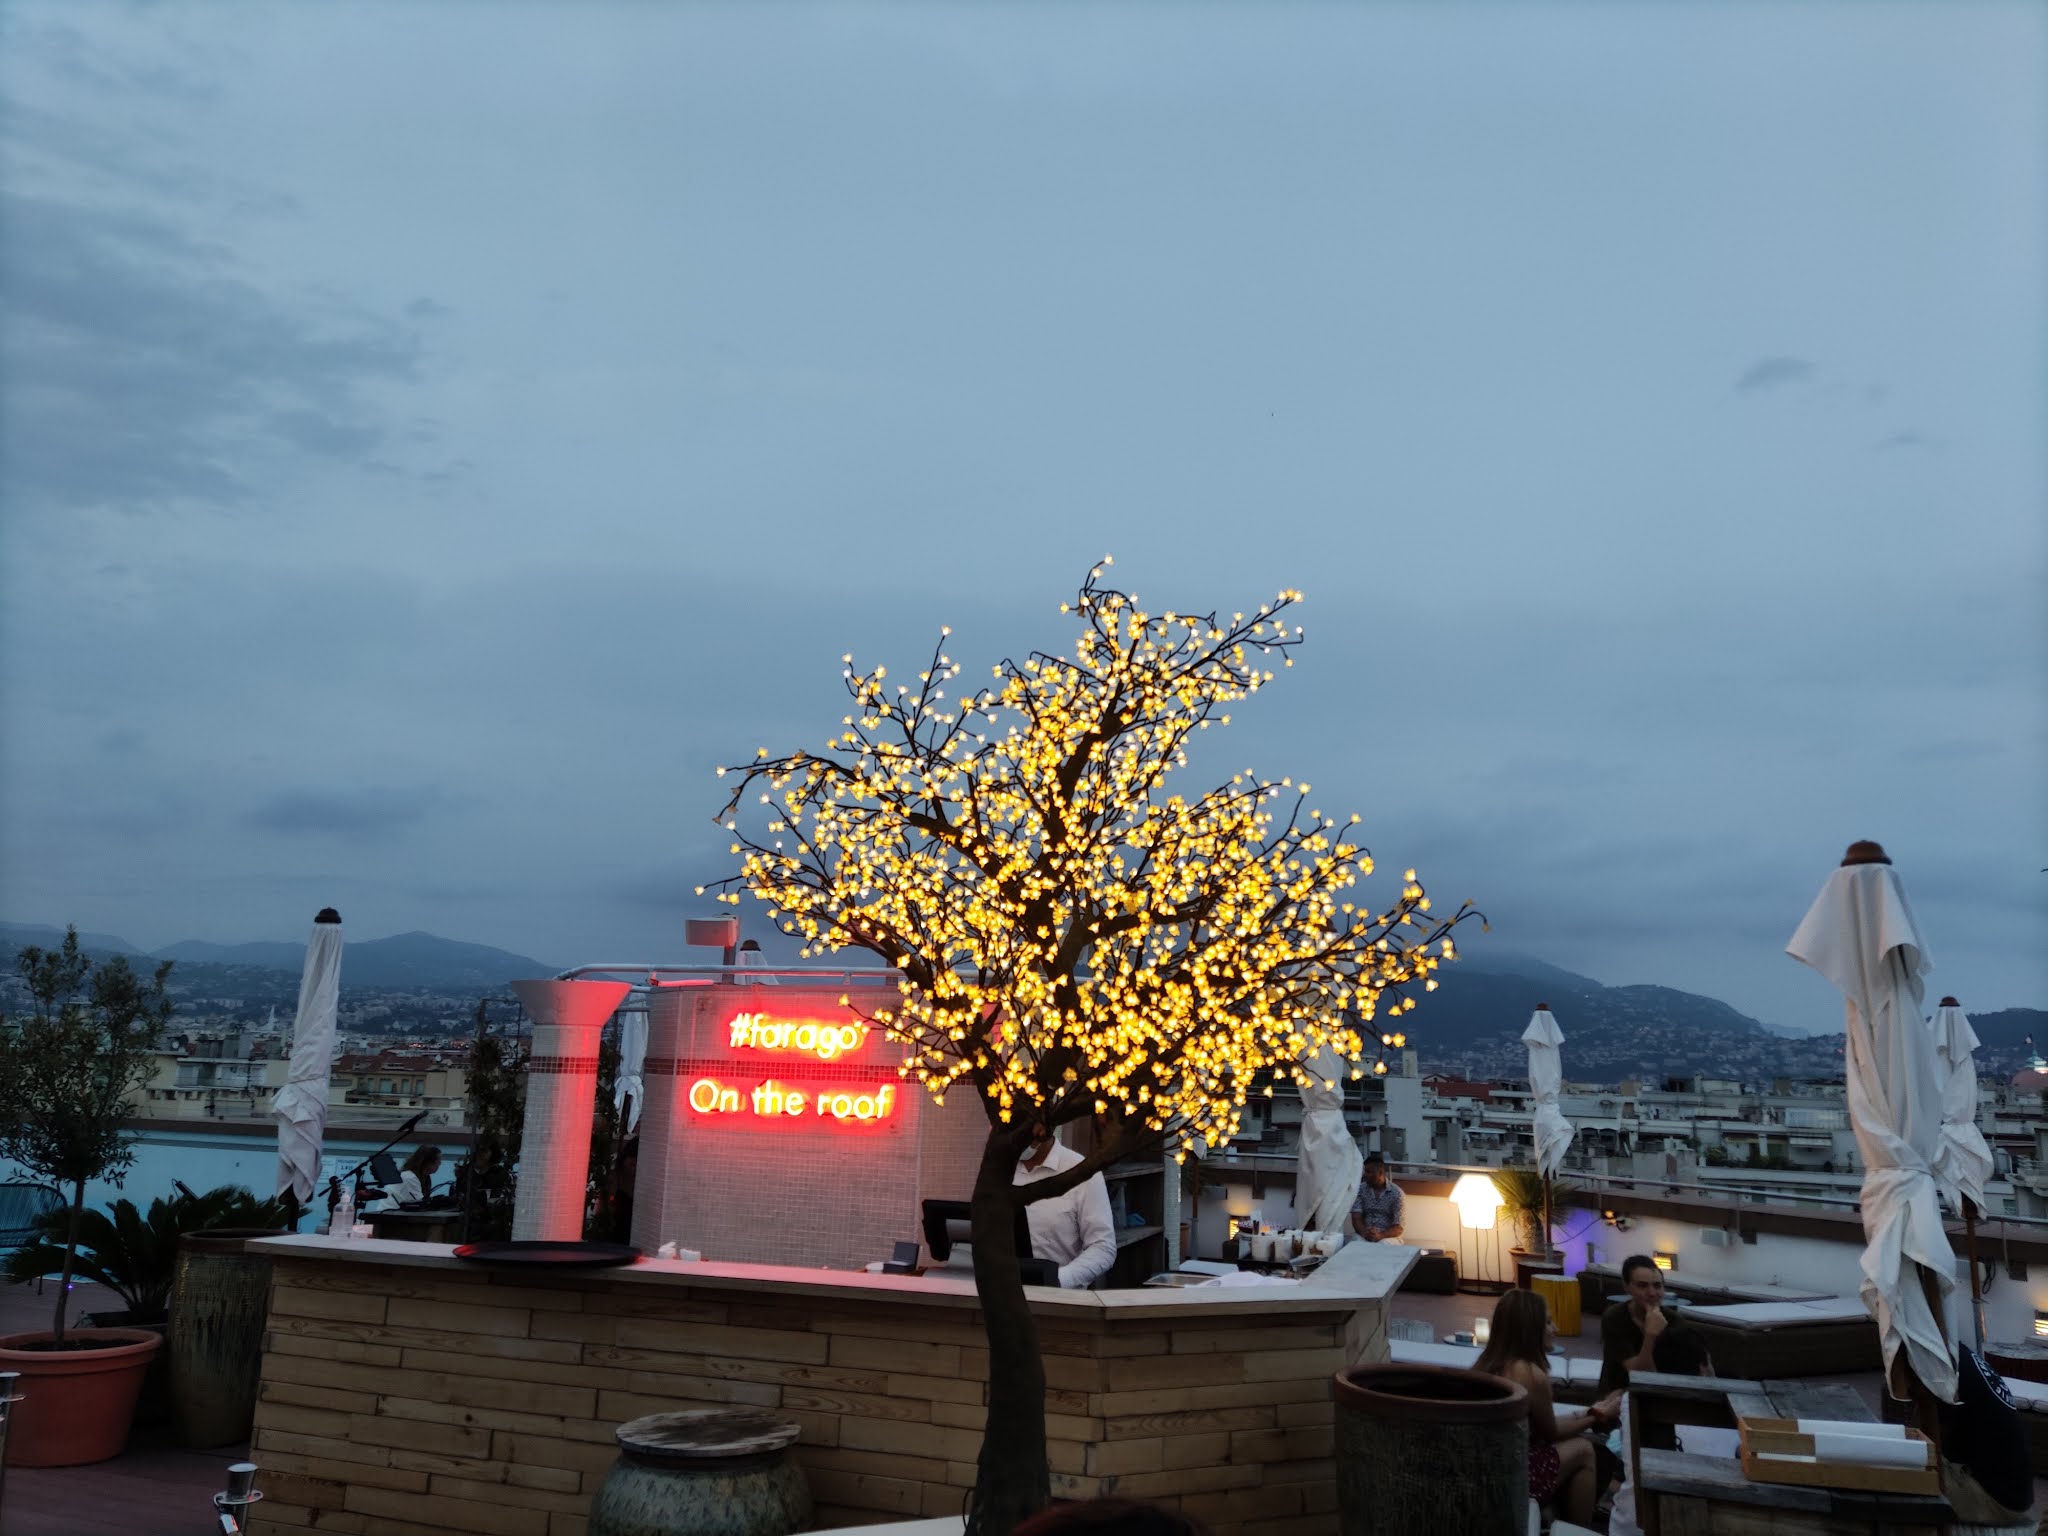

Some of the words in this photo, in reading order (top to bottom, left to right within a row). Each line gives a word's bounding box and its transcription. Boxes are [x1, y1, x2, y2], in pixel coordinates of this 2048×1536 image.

[689, 1079, 739, 1113] On
[751, 1079, 805, 1116] the
[817, 1083, 894, 1119] roof
